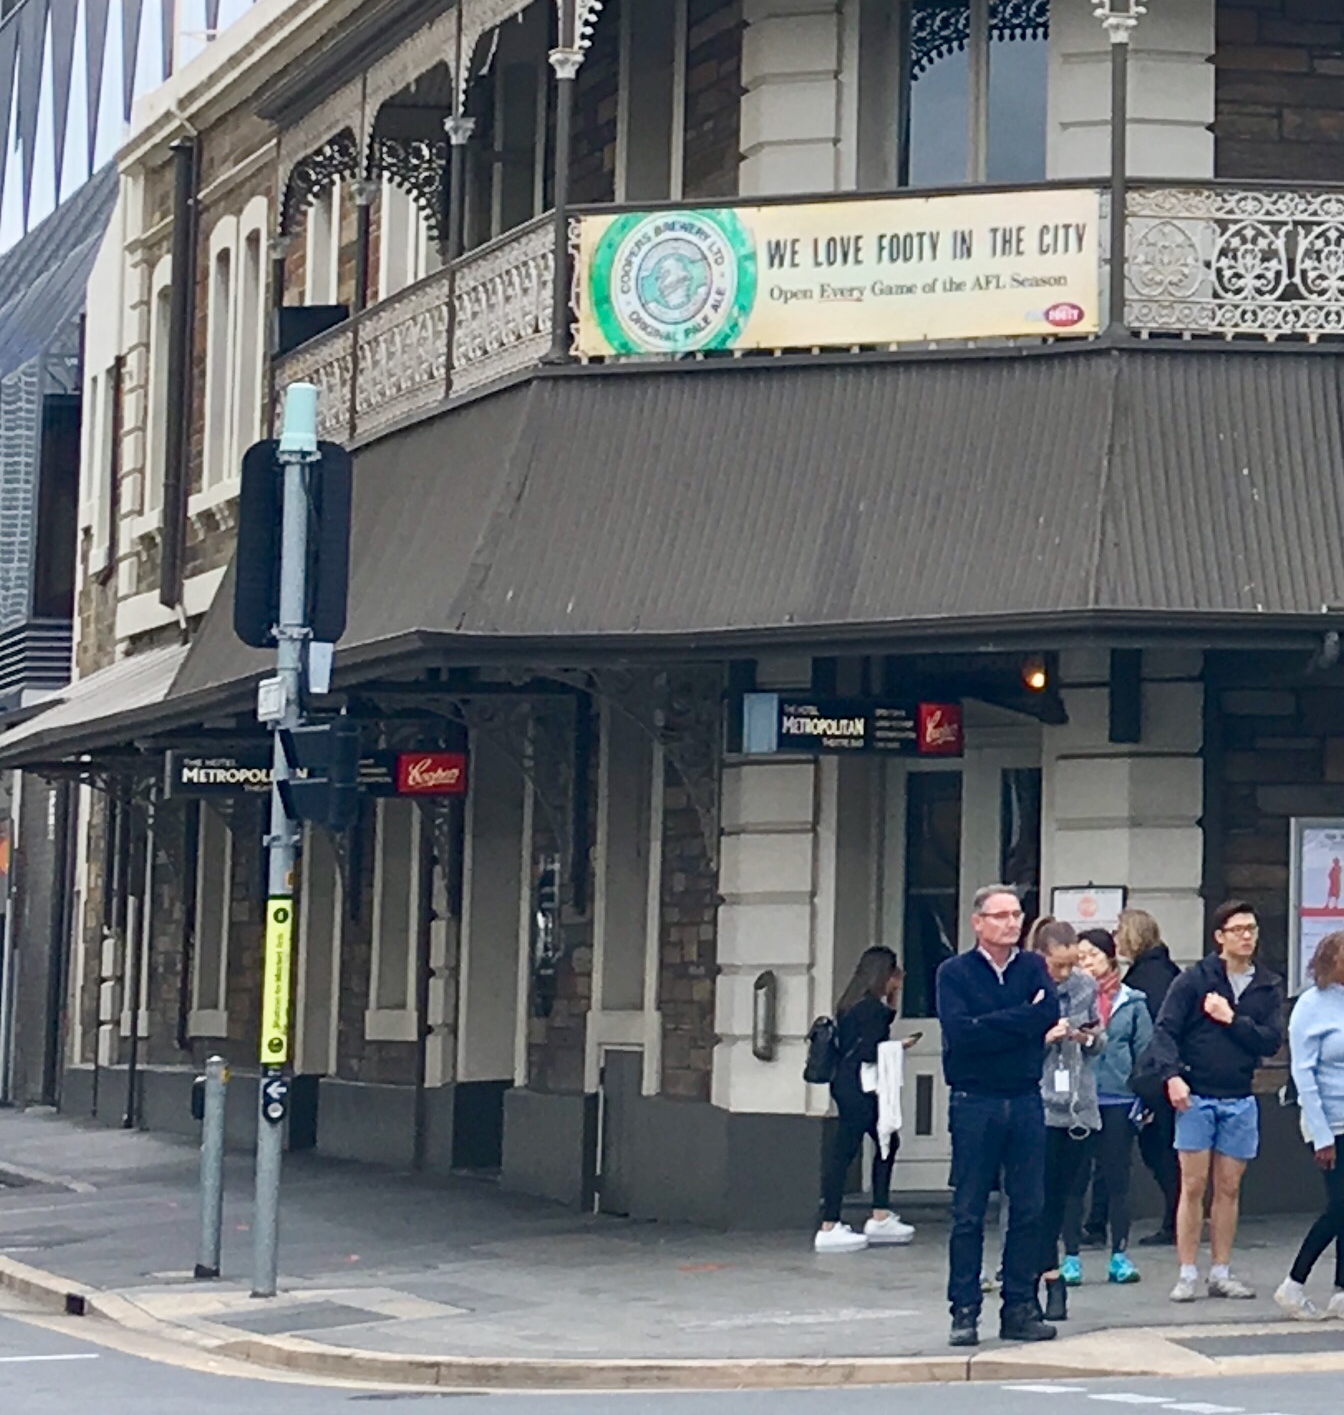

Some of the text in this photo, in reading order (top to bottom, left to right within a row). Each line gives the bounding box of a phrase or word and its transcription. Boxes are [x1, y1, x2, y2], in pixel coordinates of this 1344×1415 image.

[621, 220, 725, 295] COOPERS BREWERY LTD
[767, 222, 1087, 270] WE LOVE FOOTY IN THE CITY
[770, 273, 1068, 304] Open Every Game of the AFL Season
[629, 288, 726, 343] ORIGINAL PALE ALE
[782, 716, 866, 735] METROPOLITAN
[183, 759, 236, 767] THE HOTEL
